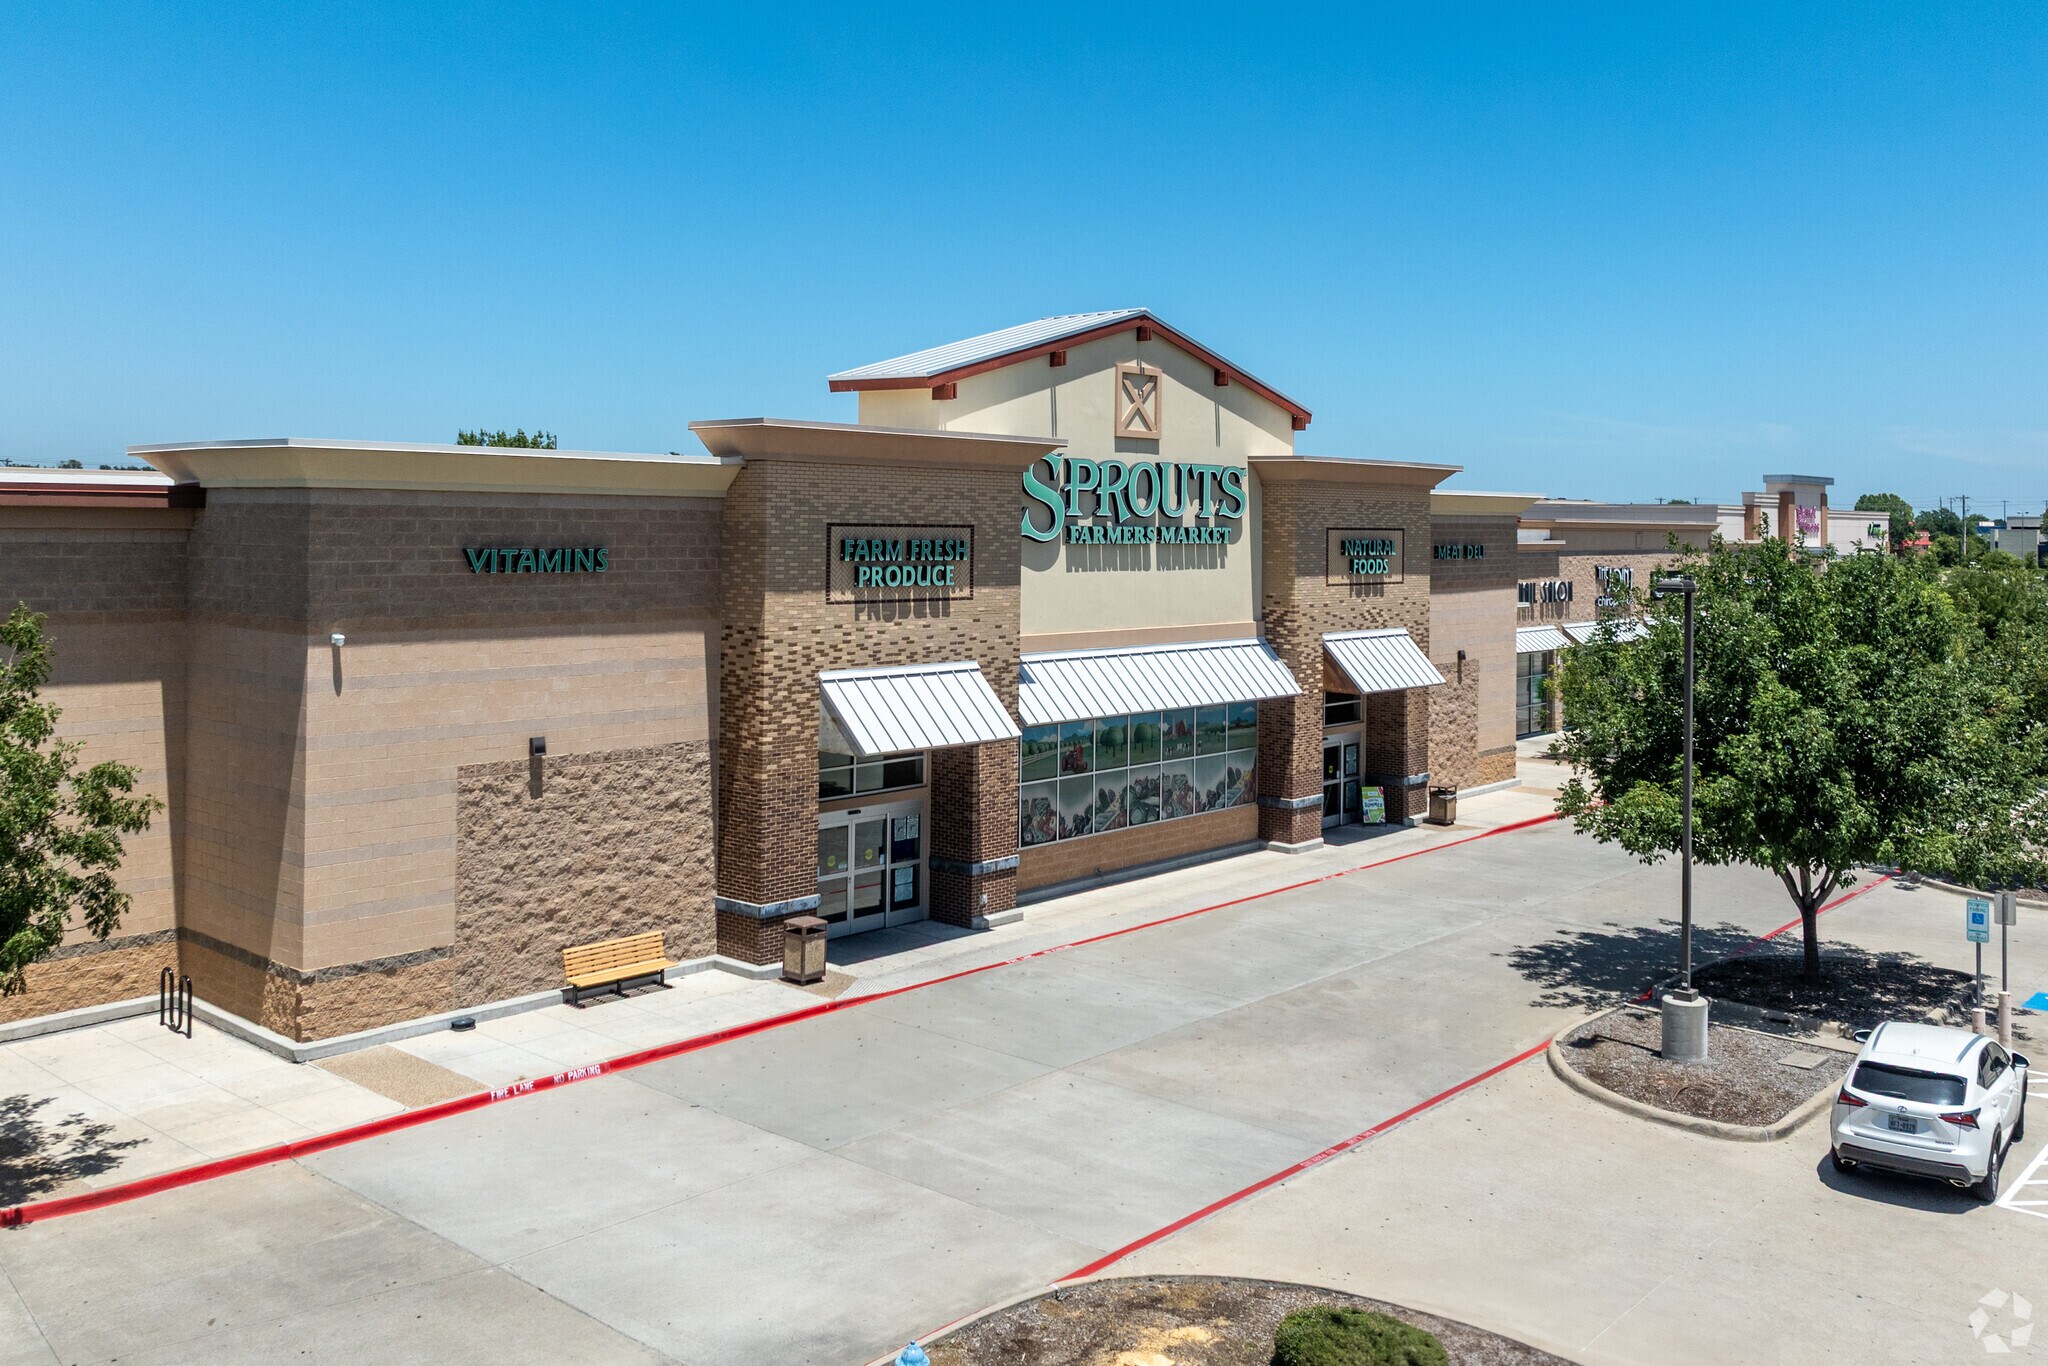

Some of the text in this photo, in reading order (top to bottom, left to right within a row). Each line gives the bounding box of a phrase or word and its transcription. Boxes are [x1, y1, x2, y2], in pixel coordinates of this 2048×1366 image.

[1021, 452, 1247, 542] SPROUTS
[1069, 525, 1232, 545] FARMERS MARKET
[844, 539, 969, 561] FARM FRESH
[1344, 539, 1397, 556] NATURAL
[1438, 544, 1487, 560] MEAT DELI
[465, 548, 609, 574] VITAMINS
[1353, 558, 1389, 575] FOODS
[858, 565, 955, 588] PRODUCE
[490, 1064, 601, 1102] FIRE LANE NO PARKING
